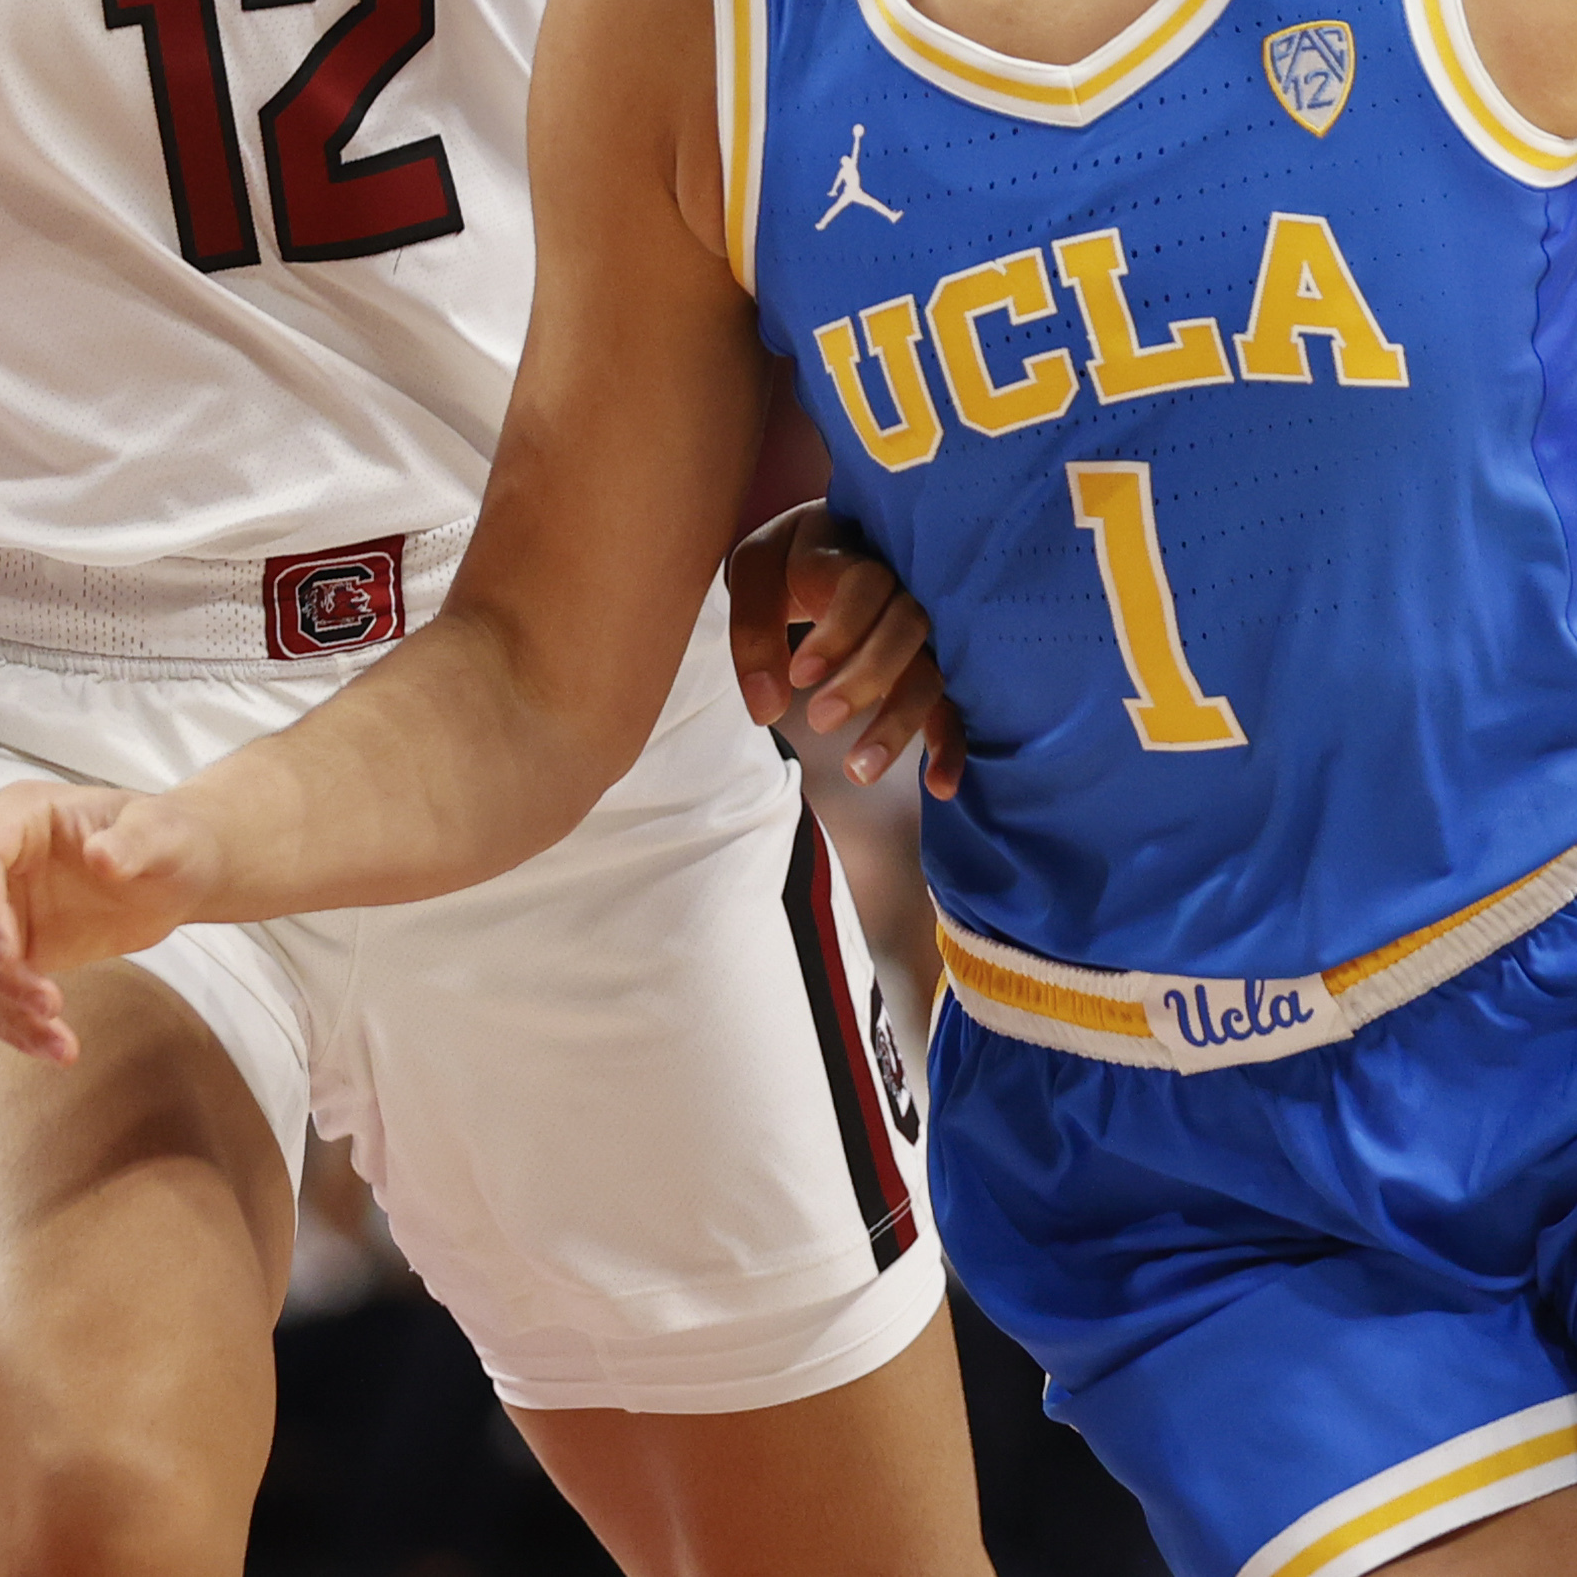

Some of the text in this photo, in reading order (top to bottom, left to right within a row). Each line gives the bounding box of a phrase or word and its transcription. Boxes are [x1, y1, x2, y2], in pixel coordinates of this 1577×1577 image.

[1271, 28, 1344, 94] PAC
[1289, 71, 1336, 111] 12
[813, 211, 1410, 473] UCLA
[1064, 460, 1250, 752] 1
[1163, 978, 1315, 1049] Ucla
